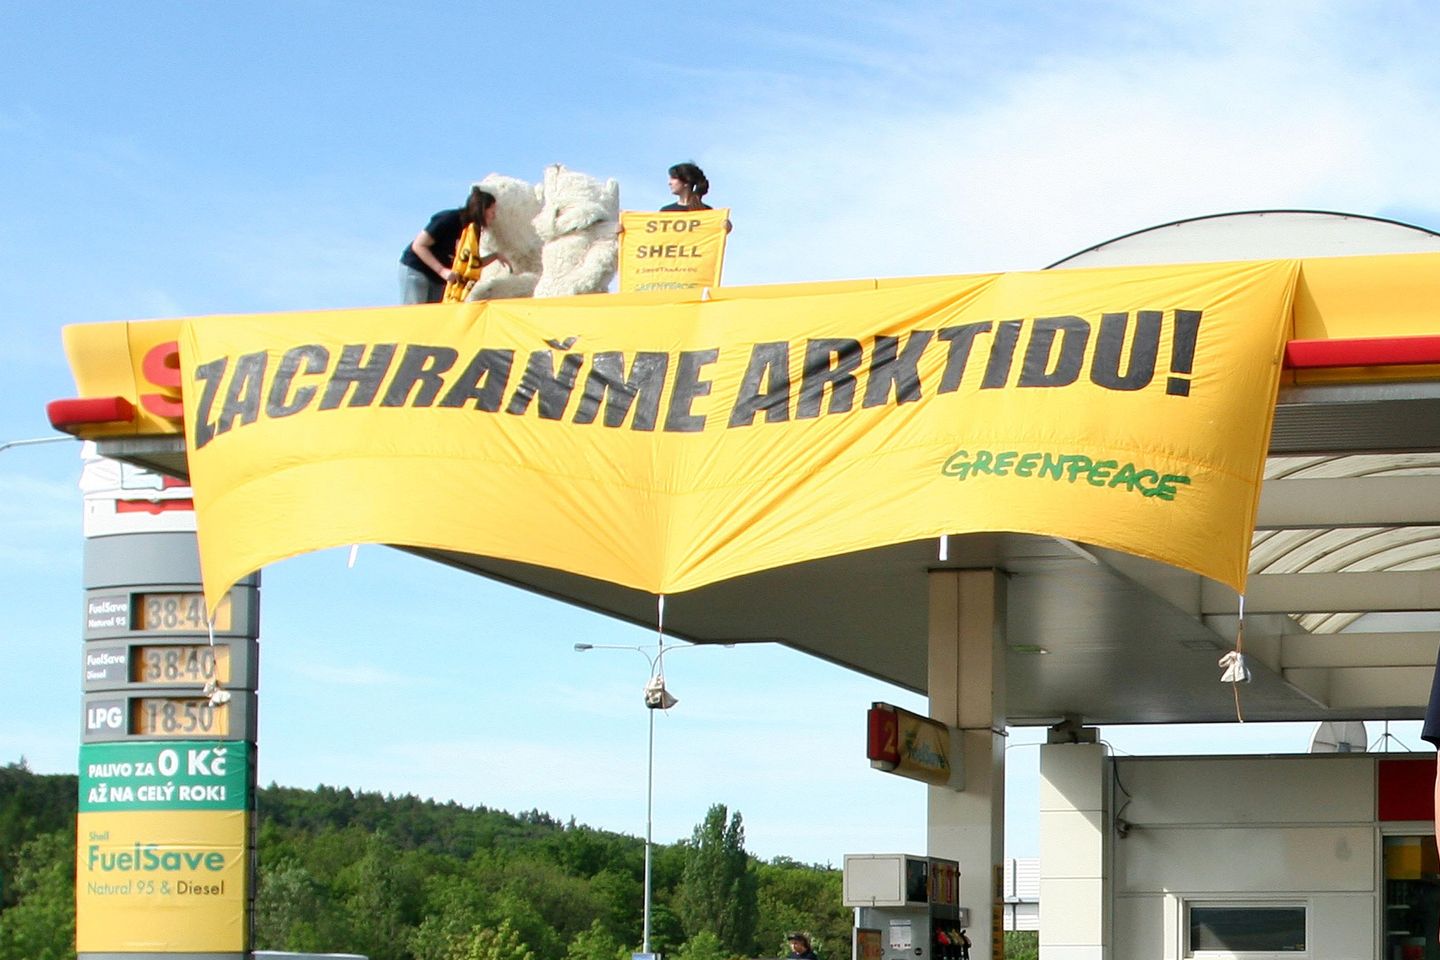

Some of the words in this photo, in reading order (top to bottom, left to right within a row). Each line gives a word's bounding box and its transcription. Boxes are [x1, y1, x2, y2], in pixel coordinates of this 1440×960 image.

[645, 219, 701, 233] STOP
[636, 245, 703, 258] SHELL
[194, 333, 720, 451] ZACHRAŇME
[726, 309, 1204, 430] ARKTIDU!
[940, 450, 1192, 502] GREENPEACE
[88, 603, 127, 614] FuelSave
[115, 617, 126, 626] 95
[87, 654, 125, 666] FuelSave
[88, 707, 122, 729] LPG
[883, 721, 896, 754] 2
[88, 763, 132, 778] PALIVO
[135, 762, 155, 776] ZA
[158, 748, 179, 776] 0
[187, 747, 227, 776] Kč
[88, 783, 108, 803] AŽ
[110, 787, 135, 801] NA
[137, 782, 175, 801] CELÝ
[179, 786, 226, 800] ROK!
[88, 843, 225, 871] FuelSave
[88, 880, 131, 895] Natural
[137, 881, 154, 895] 95
[160, 882, 170, 894] &
[177, 881, 224, 895] Diesel
